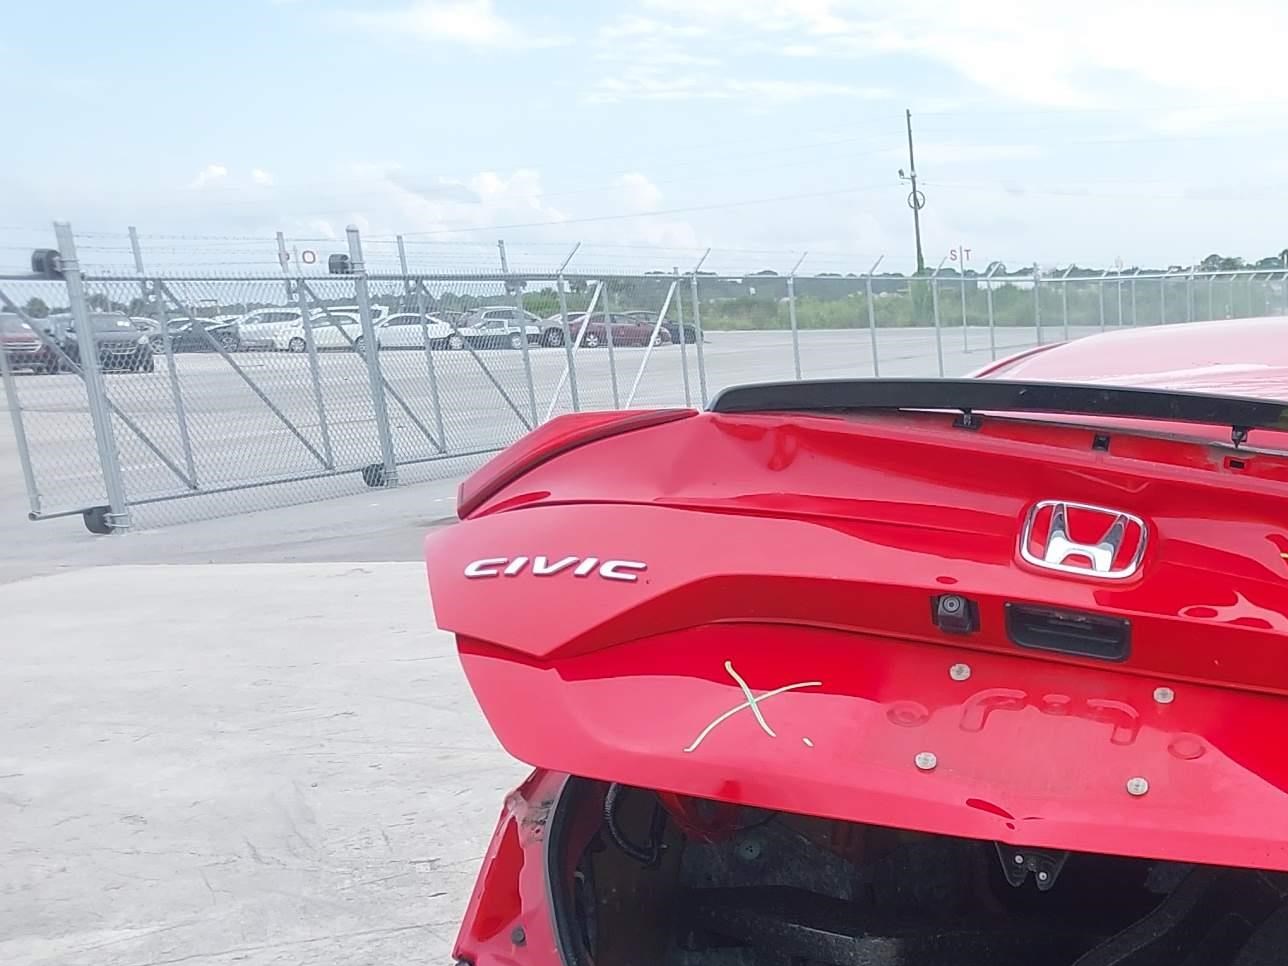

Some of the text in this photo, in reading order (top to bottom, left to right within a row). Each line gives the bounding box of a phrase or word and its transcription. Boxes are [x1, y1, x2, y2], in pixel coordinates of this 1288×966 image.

[950, 249, 958, 261] S
[964, 249, 971, 261] T
[463, 556, 648, 583] CIVIC
